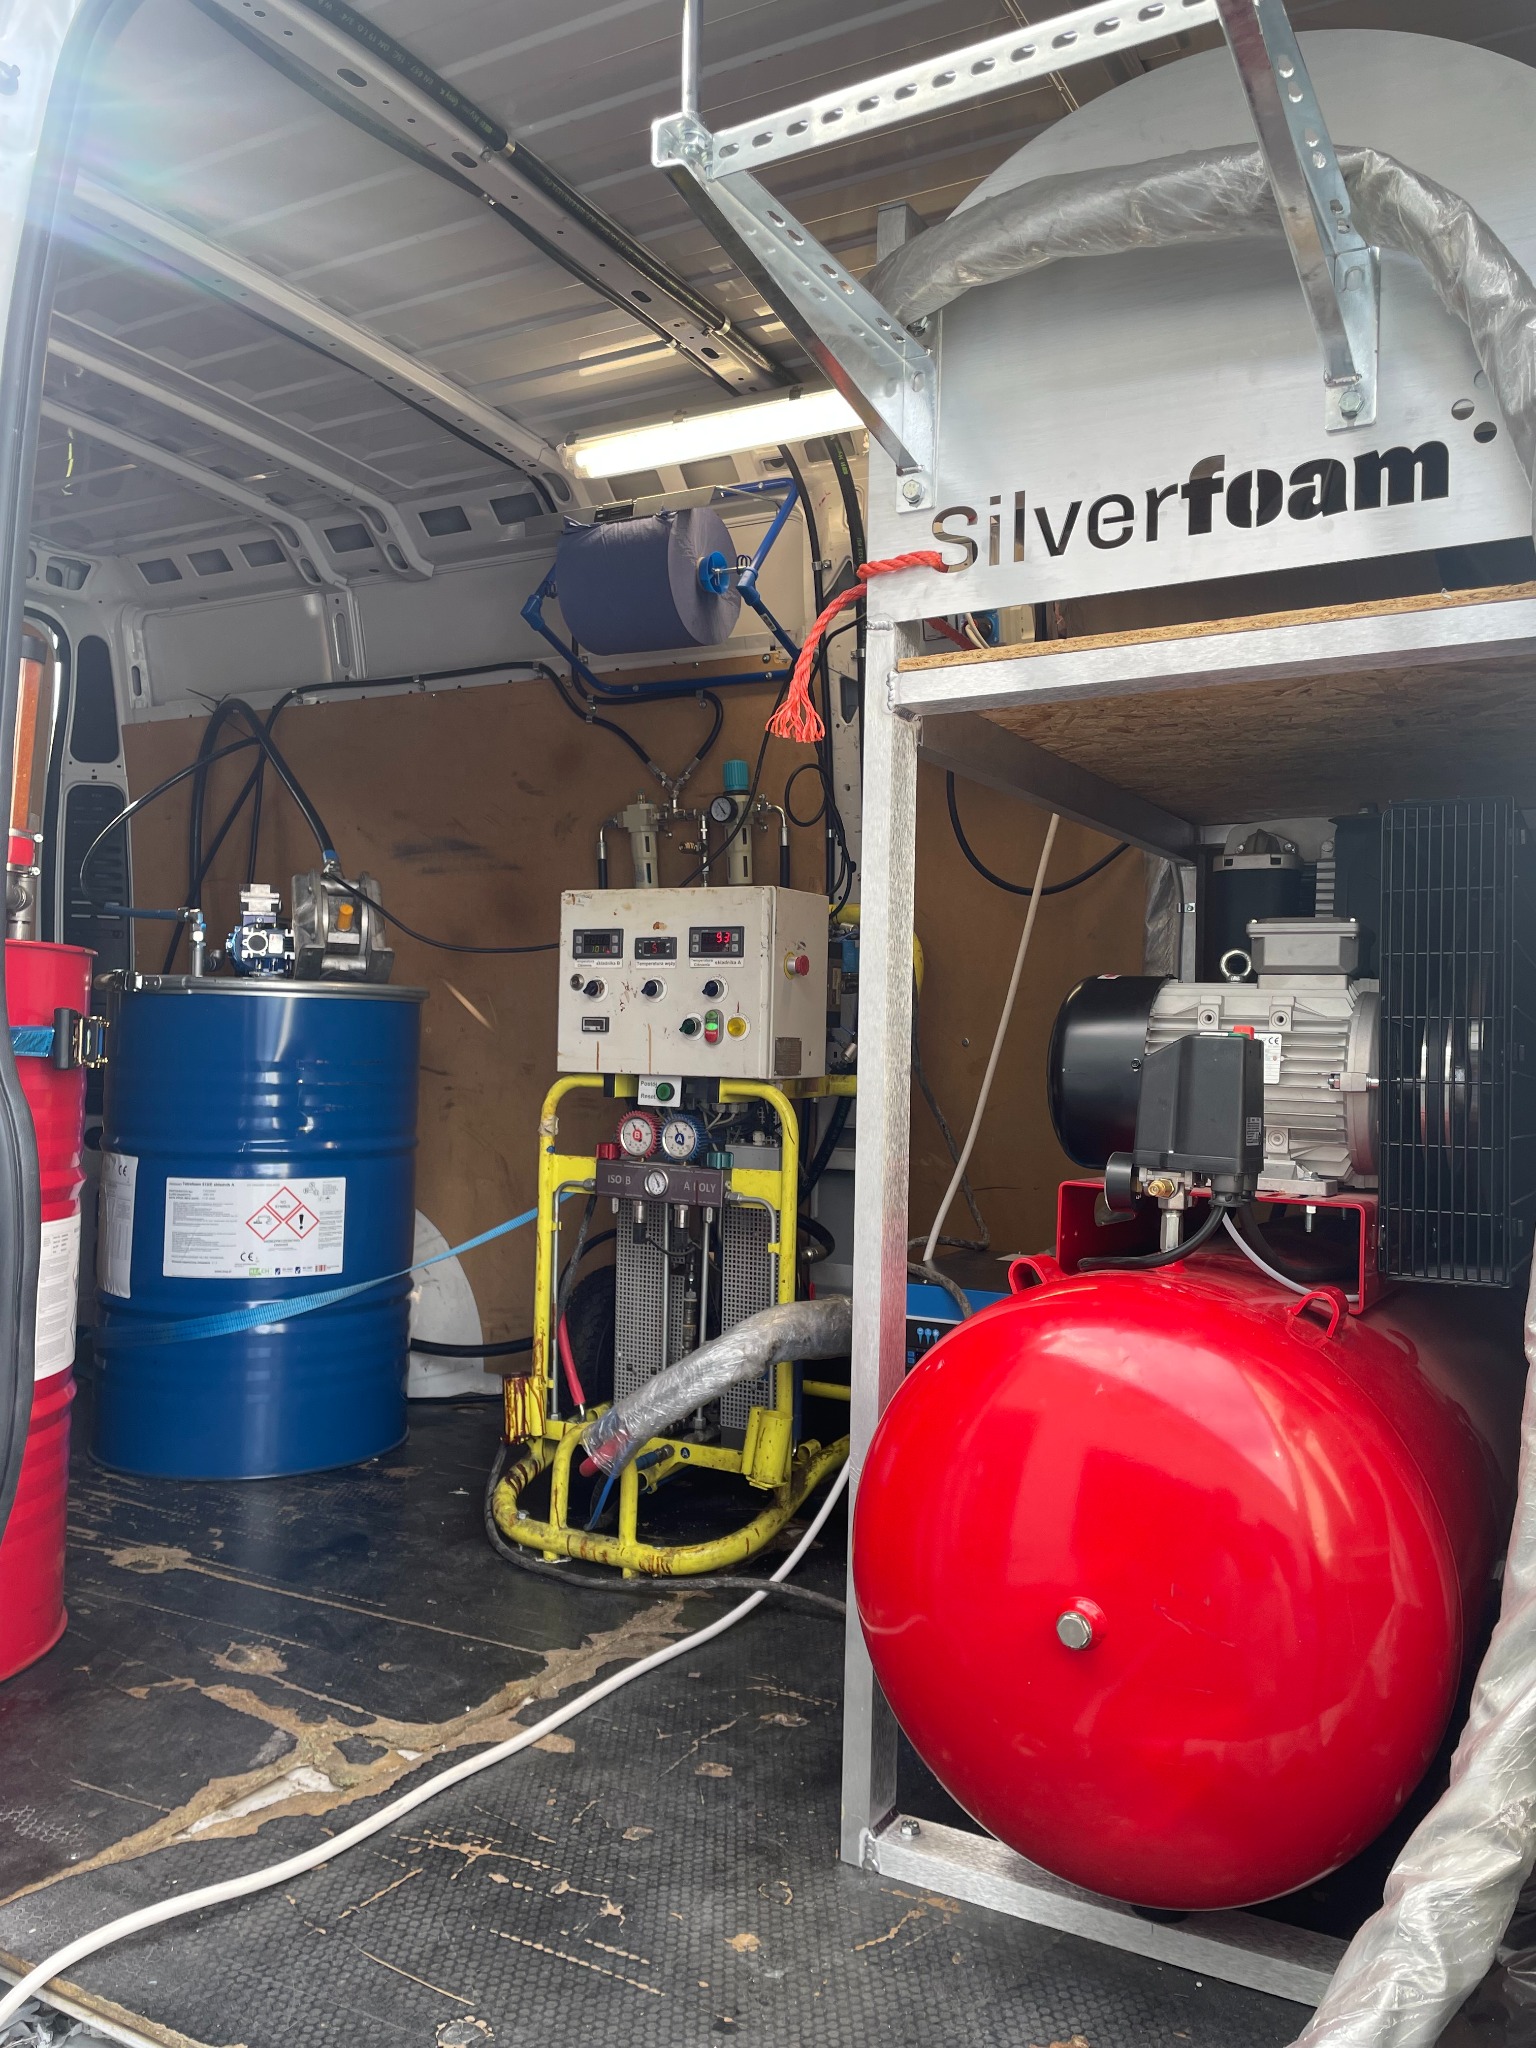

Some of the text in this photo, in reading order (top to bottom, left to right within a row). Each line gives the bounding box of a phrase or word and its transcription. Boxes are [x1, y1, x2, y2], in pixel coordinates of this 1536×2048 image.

[932, 440, 1449, 573] Silverfoam
[634, 1131, 640, 1139] B
[676, 1134, 683, 1144] A
[607, 1174, 632, 1186] ISO B
[683, 1181, 691, 1191] A
